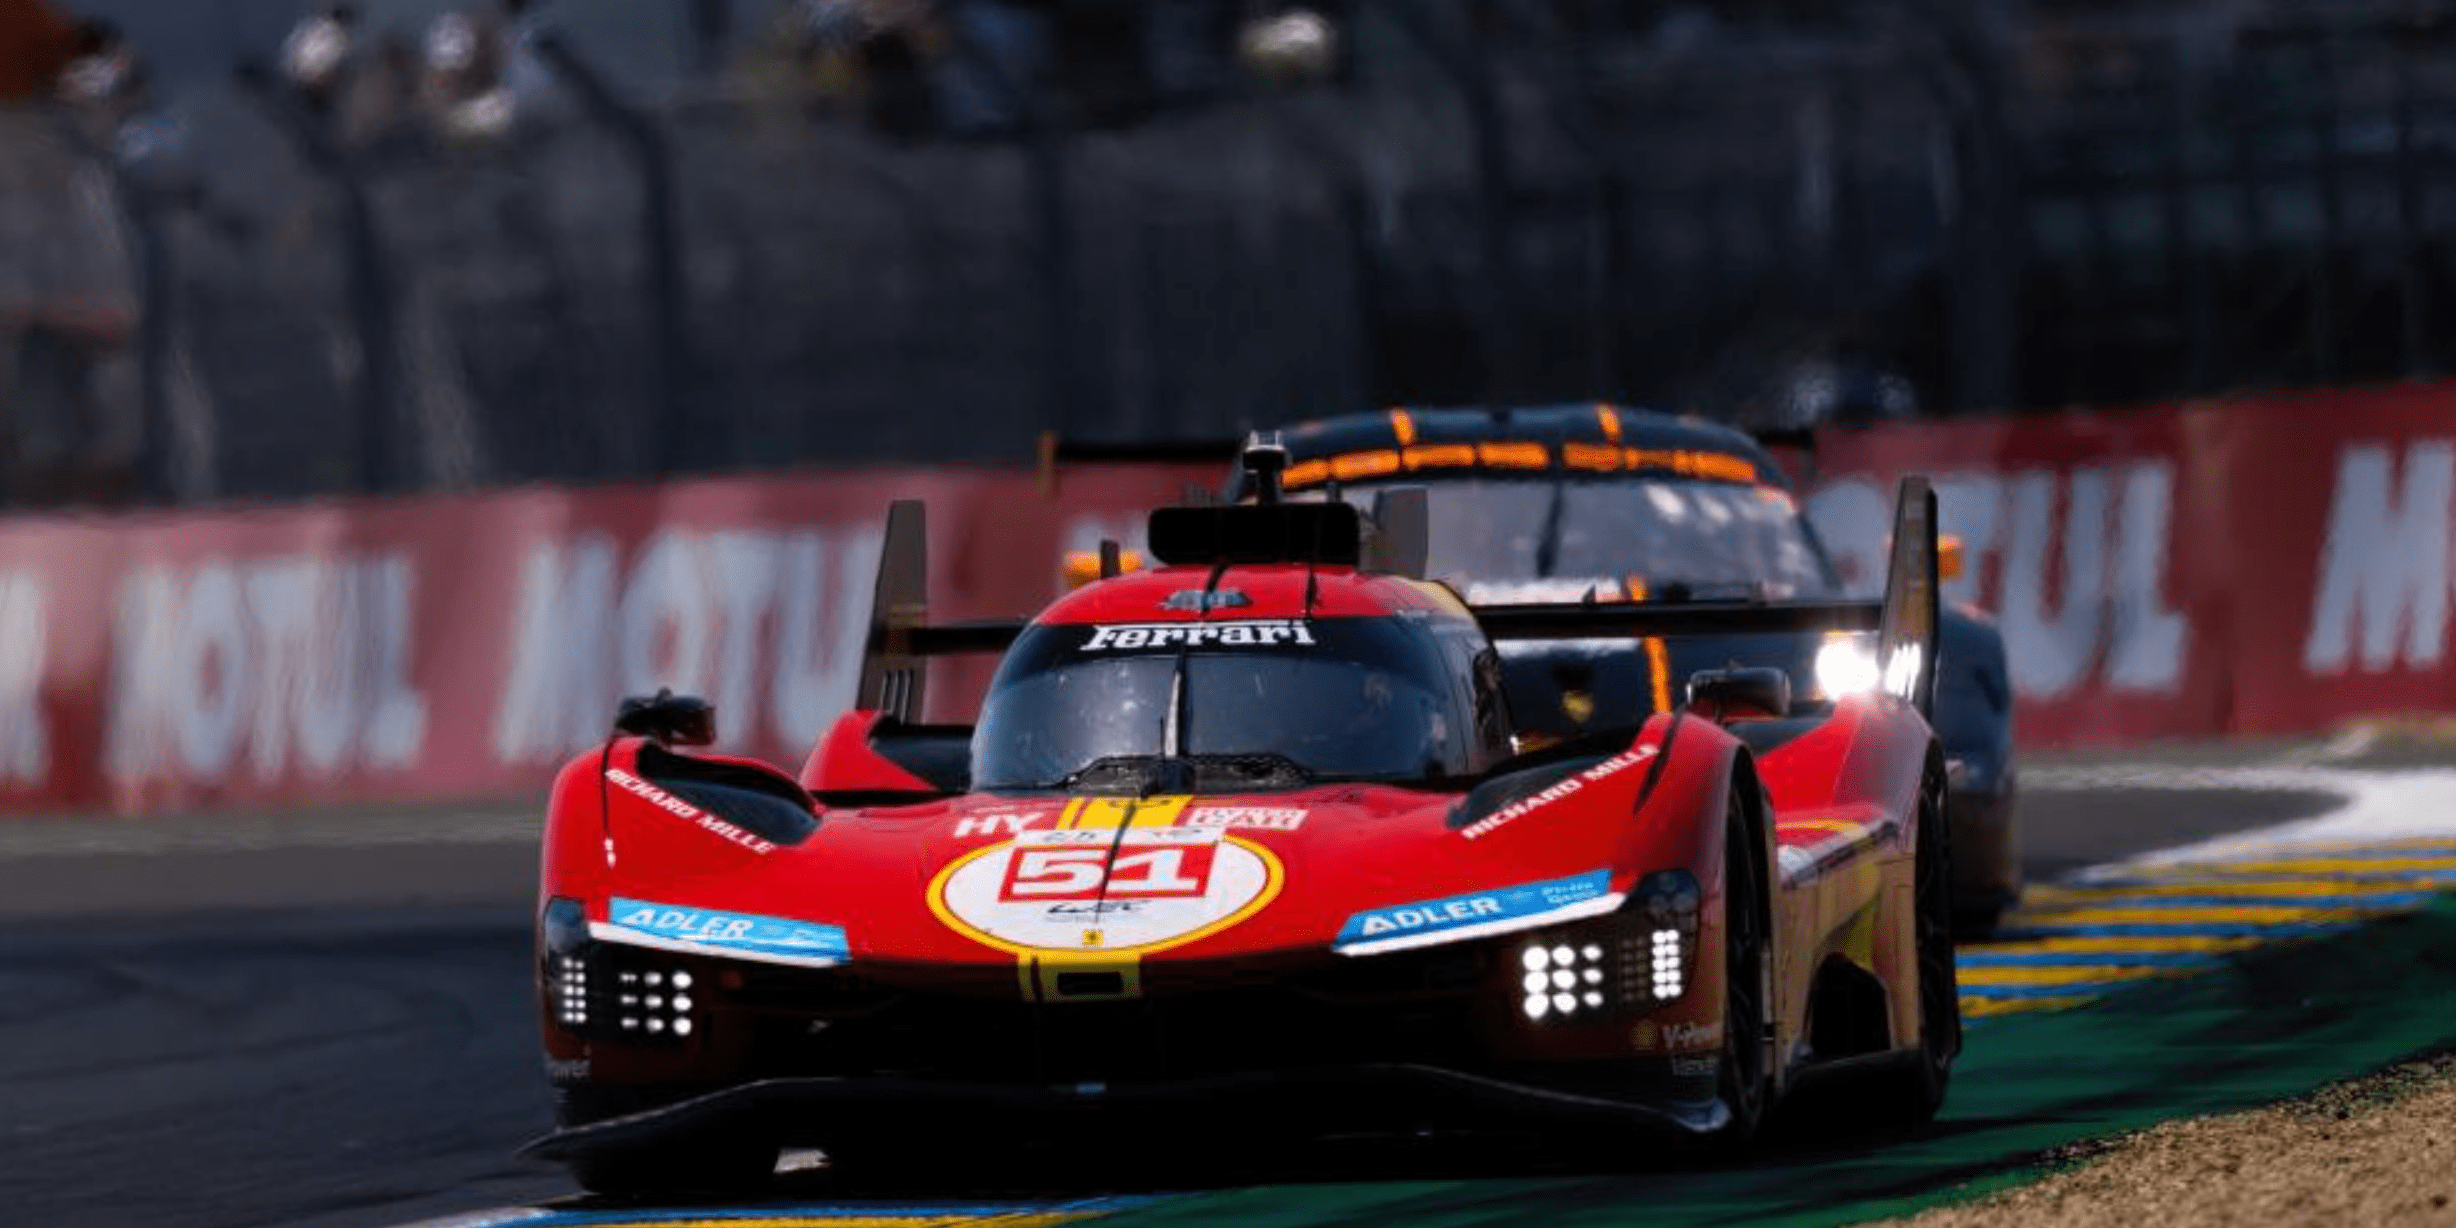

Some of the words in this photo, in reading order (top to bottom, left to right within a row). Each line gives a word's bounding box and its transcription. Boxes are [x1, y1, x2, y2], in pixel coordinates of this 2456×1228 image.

[497, 525, 886, 756] MOTU
[1081, 620, 1317, 650] Ferrari
[605, 768, 699, 819] RICHARD
[696, 814, 777, 854] MILLE
[953, 811, 1045, 838] HY
[1460, 779, 1584, 840] RICHARD
[1011, 848, 1199, 895] 51
[621, 908, 755, 942] ADLER
[1361, 896, 1502, 936] ADLER
